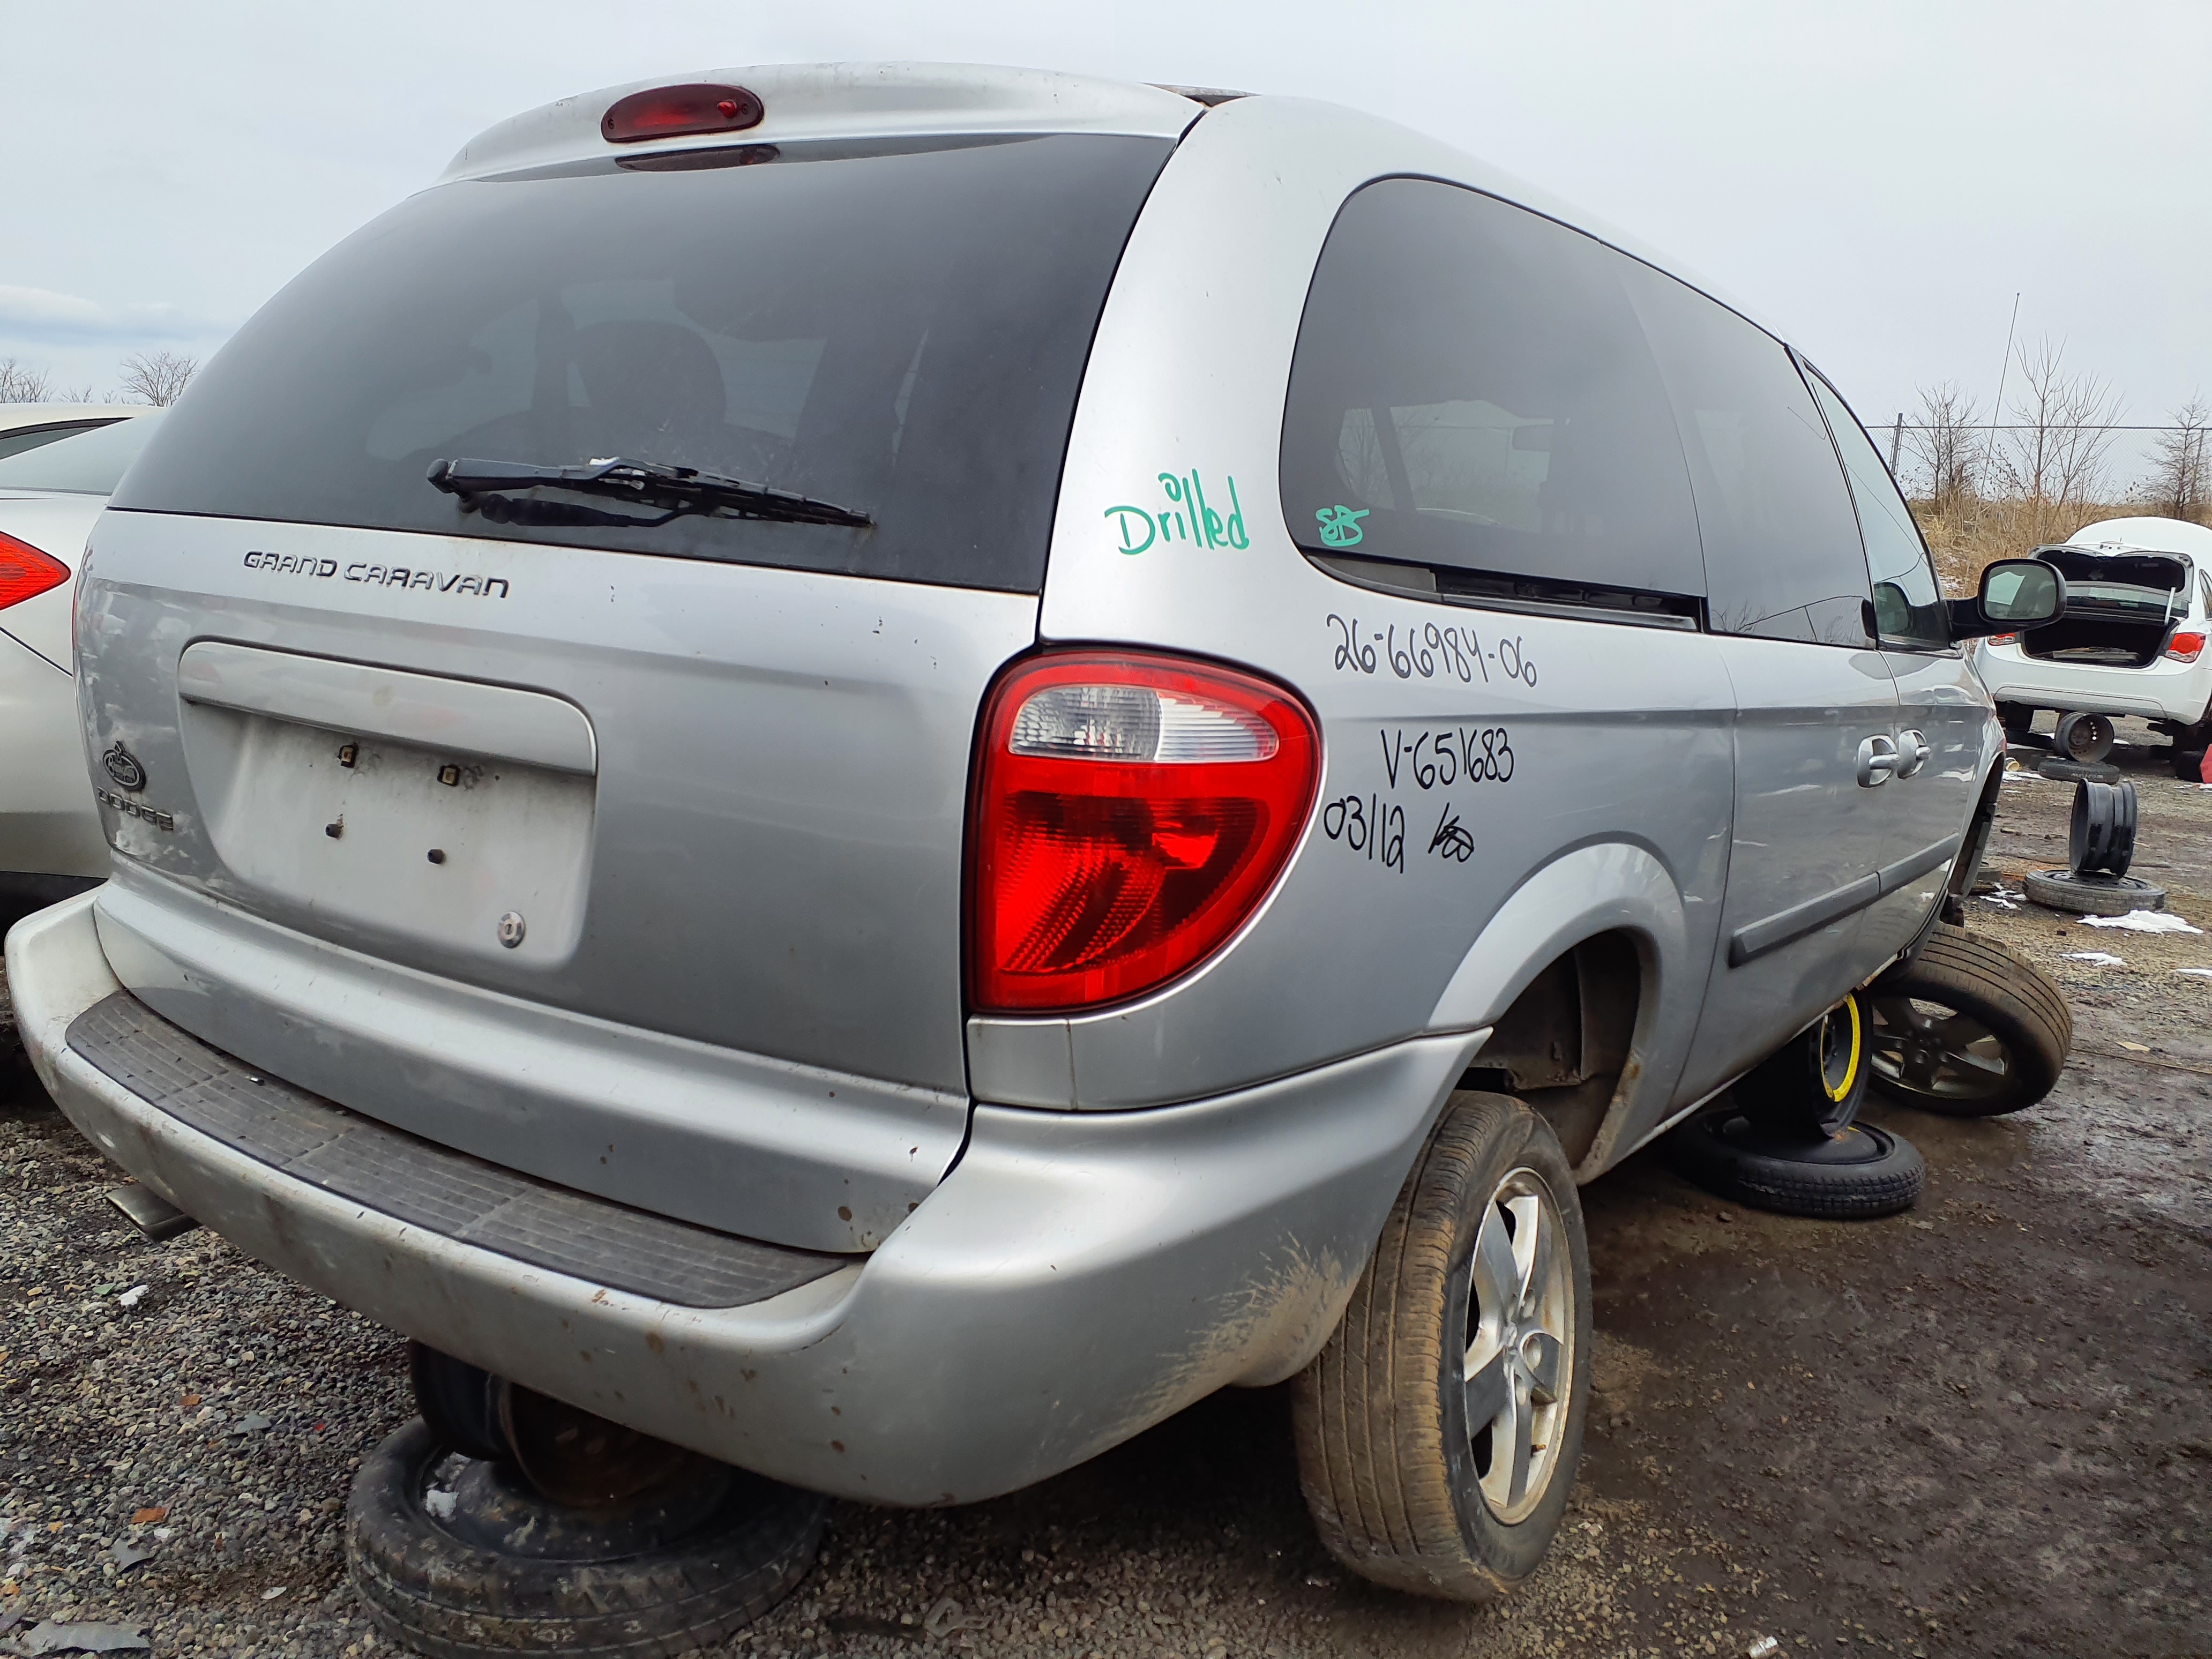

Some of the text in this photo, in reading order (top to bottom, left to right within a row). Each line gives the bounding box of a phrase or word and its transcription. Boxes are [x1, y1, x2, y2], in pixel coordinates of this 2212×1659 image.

[1104, 468, 1250, 555] Drilled
[243, 550, 509, 599] GRAND CARAVAN
[1327, 614, 1537, 687] 26-66984-06
[1381, 728, 1514, 789] V-651683
[1324, 793, 1405, 874] 03/12
